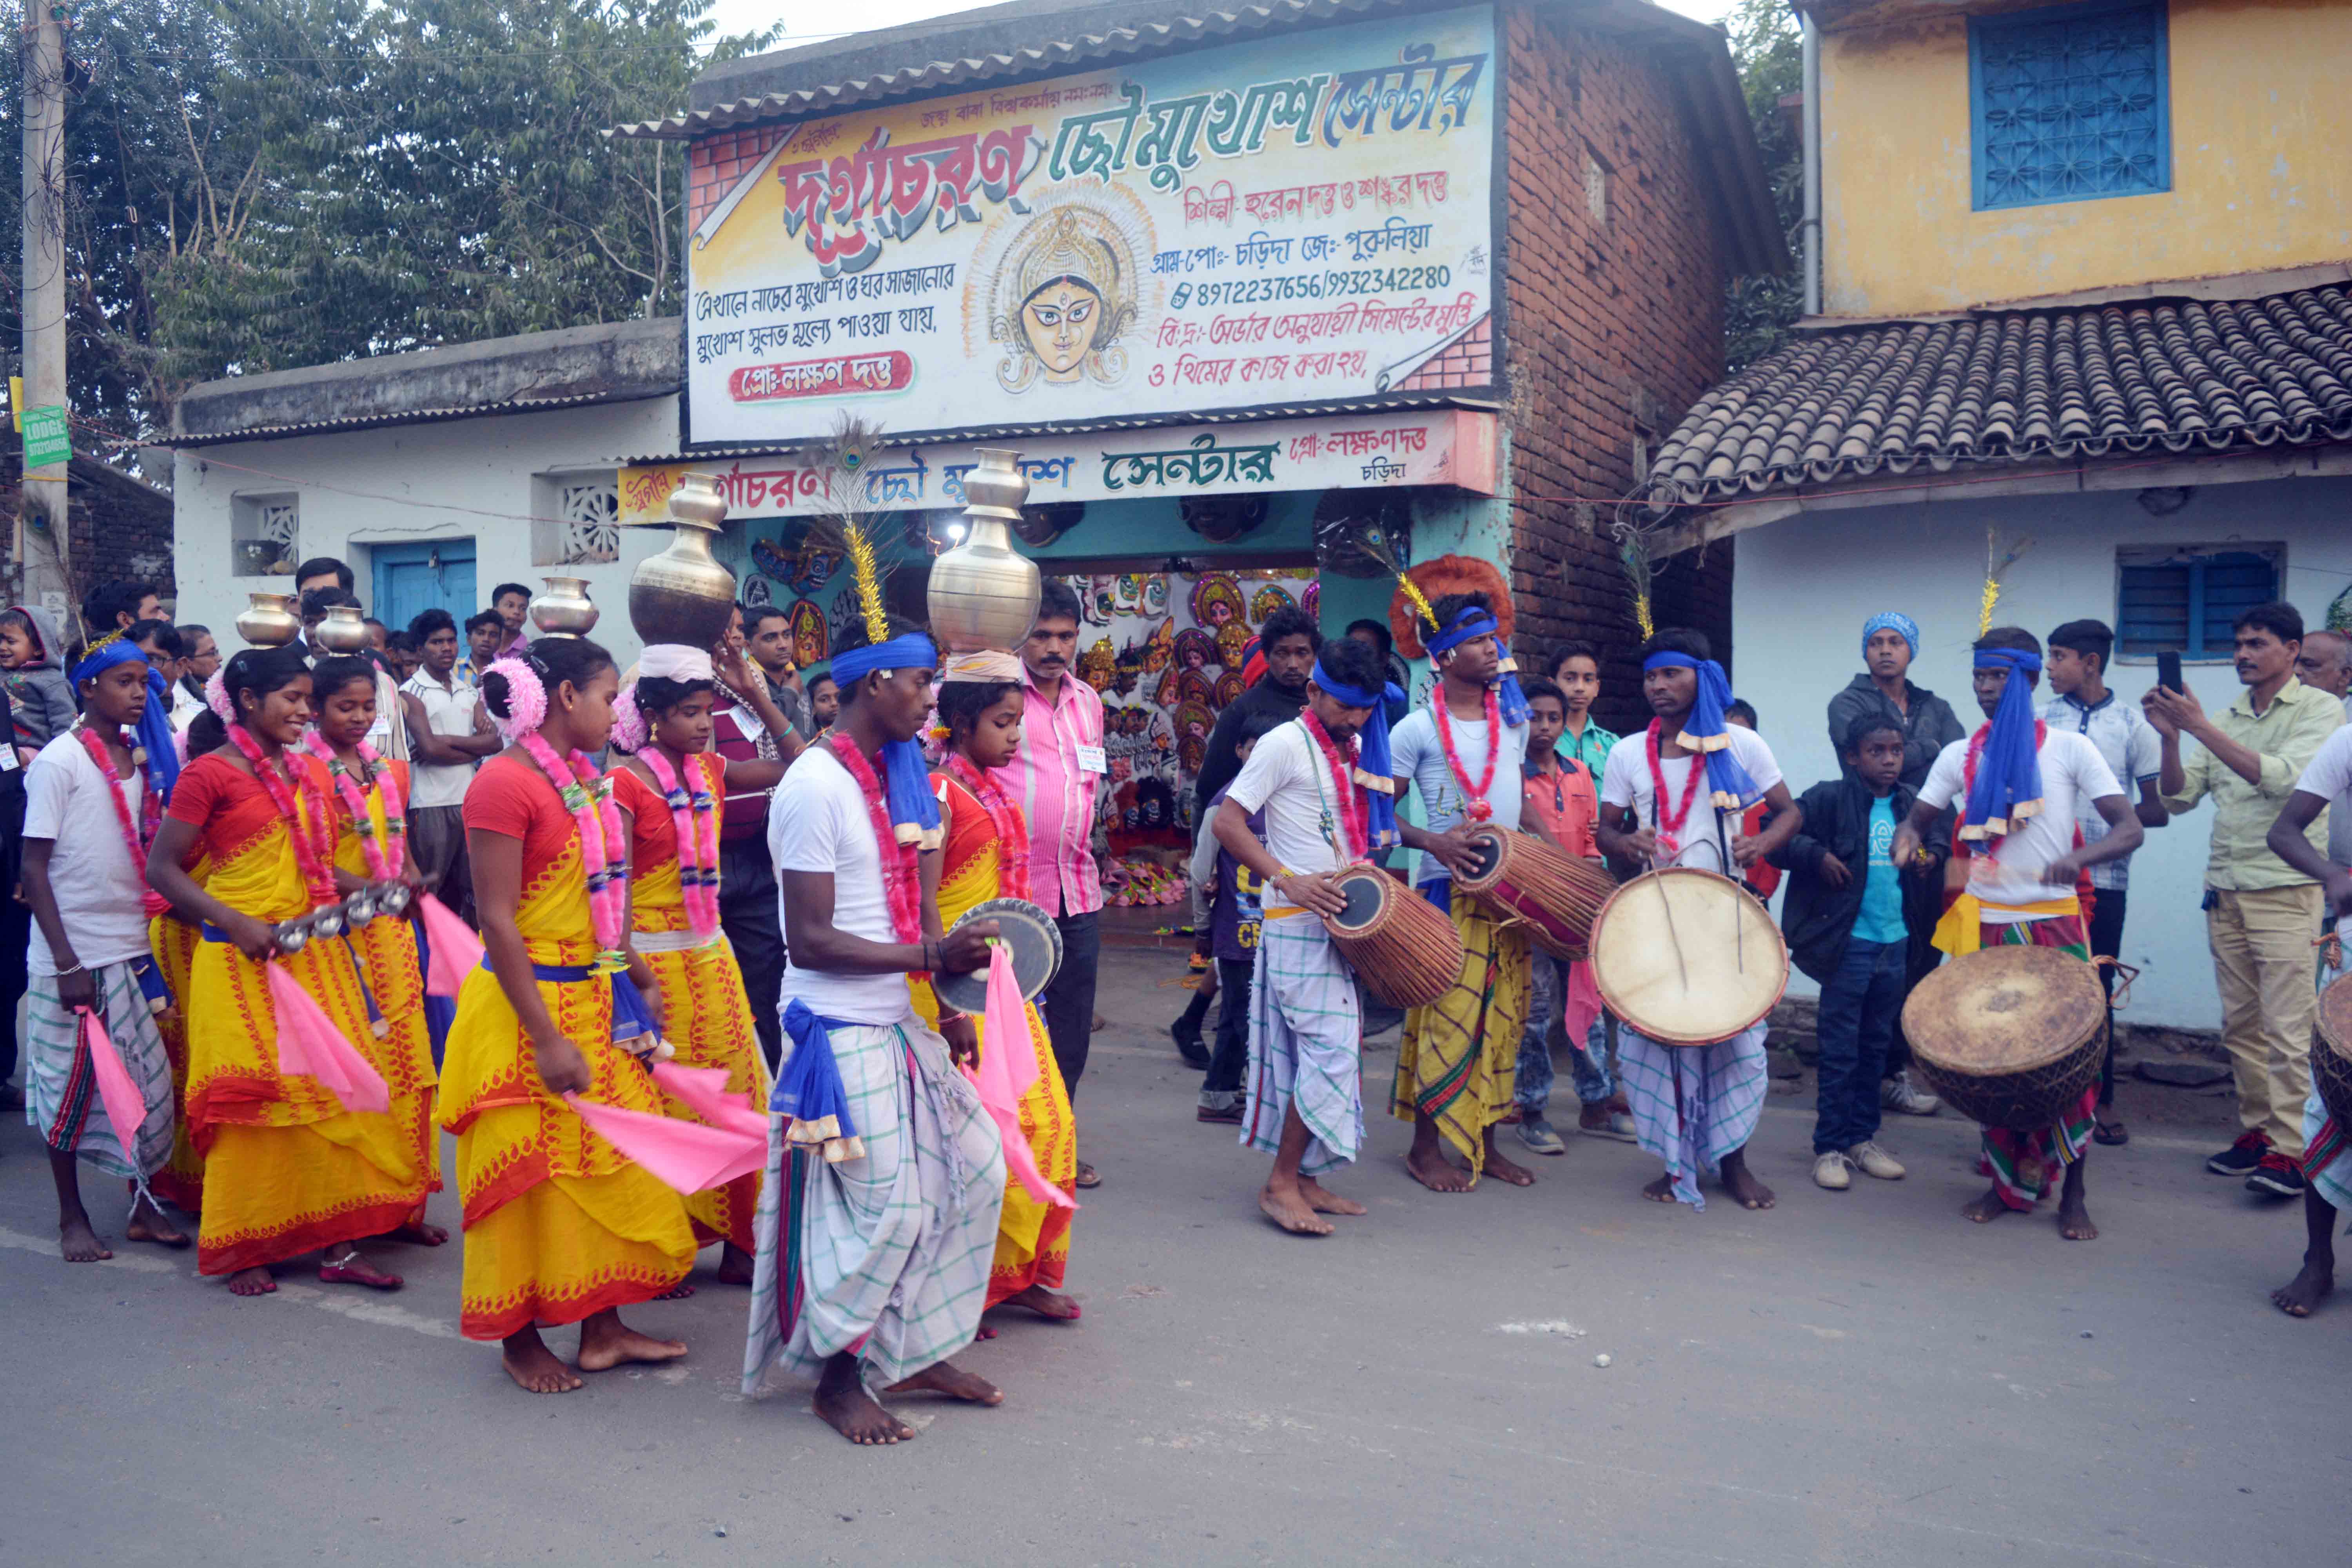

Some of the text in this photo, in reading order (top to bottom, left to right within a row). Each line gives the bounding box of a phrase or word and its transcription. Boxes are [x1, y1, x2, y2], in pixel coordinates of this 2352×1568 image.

[956, 100, 984, 121] বাবা
[1134, 74, 1331, 192] মুখোশ
[1322, 42, 1489, 147] সেন্টার
[1245, 187, 1305, 223] হরেন
[1307, 182, 1338, 217] দত্ত
[1341, 181, 1354, 210] ও
[1414, 171, 1447, 205] দত্ত
[1236, 230, 1295, 269] চড়িদা
[752, 285, 793, 312] নাচের
[795, 278, 843, 312] মুখোশ
[846, 276, 858, 300] ও
[860, 273, 884, 299] ঘর
[884, 263, 956, 296] সাজানোর
[1197, 265, 1452, 307] 8972237656/9932342280
[697, 330, 745, 365] মুখোশ
[748, 324, 789, 357] সুলভ
[792, 319, 831, 348] মূল্যে
[837, 311, 892, 338] পাওয়া
[1210, 311, 1272, 344] অর্ডার
[851, 355, 893, 389] দত্ত
[1149, 364, 1165, 387] ও
[1173, 353, 1236, 386] থিমের
[1240, 355, 1290, 381] কাজ
[1294, 352, 1336, 379] করা
[26, 419, 65, 441] LODGE
[1398, 427, 1428, 454] দত্ত
[1102, 433, 1281, 489] সেন্টার
[1360, 456, 1406, 482] চড়িদা
